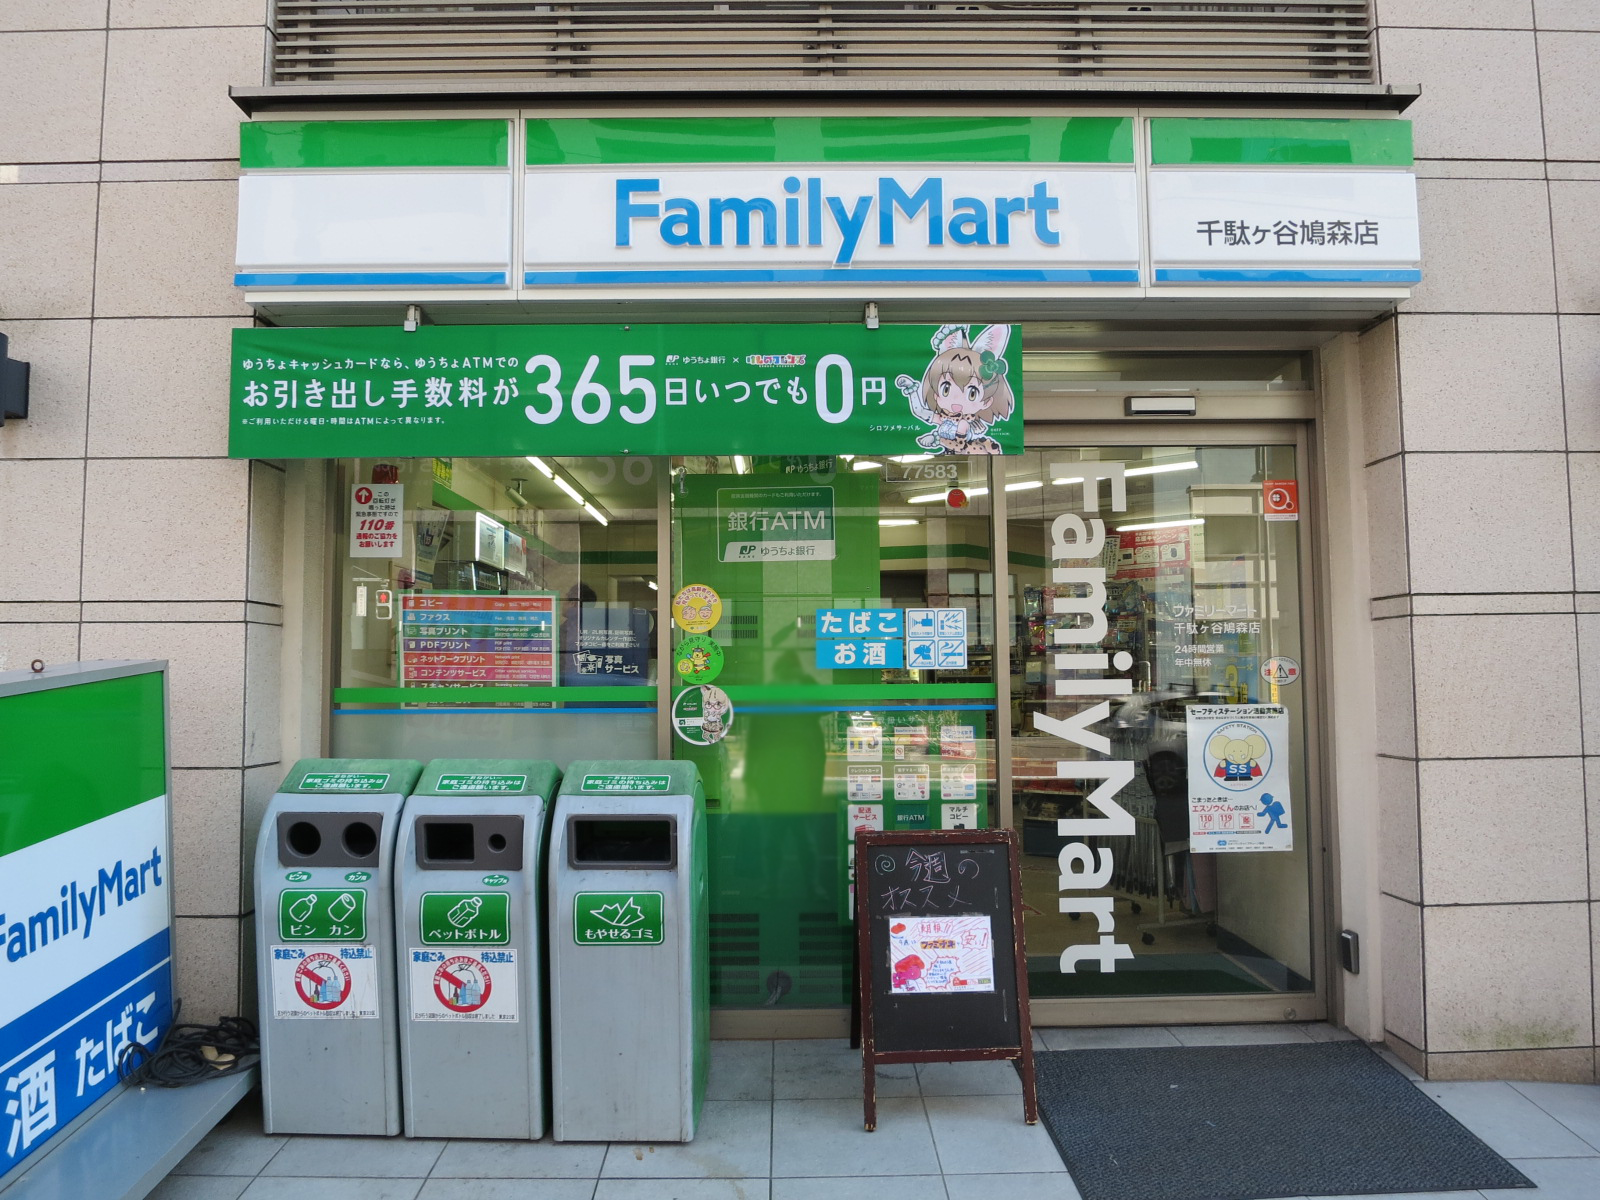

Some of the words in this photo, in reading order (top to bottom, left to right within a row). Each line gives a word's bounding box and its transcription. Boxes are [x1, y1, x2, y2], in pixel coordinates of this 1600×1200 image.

[614, 176, 1060, 267] FamilyMart
[1196, 219, 1379, 247] 千駄ヶ谷鳩森店
[242, 356, 519, 371] ゆうちょキャッシュカードなら、ゆうちょATMでの
[682, 355, 726, 364] ゆうちょ銀行
[242, 377, 519, 409] お引き出し手数料が
[524, 354, 656, 425] 365
[665, 376, 808, 406] 日いつでも
[814, 353, 854, 424] 0
[861, 376, 886, 405] 円
[868, 423, 921, 432] シロツメサーバル
[797, 458, 833, 474] ゆうちょ銀行
[901, 464, 958, 479] 77583
[359, 519, 395, 530] 110番
[727, 510, 825, 532] 銀行ATM
[760, 546, 816, 556] ゆうちょ銀行
[419, 599, 443, 607] コピー
[419, 613, 450, 621] ファクス
[1173, 604, 1257, 618] ファミリーマート
[821, 611, 898, 634] たばこ
[1173, 622, 1261, 634] 千駄ヶ谷鳩森店
[419, 628, 468, 636] 写真プリント
[420, 640, 471, 648] PDFプリント
[1174, 644, 1225, 654] 24時間営業
[420, 655, 486, 664] ネットワークプリント
[604, 655, 623, 664] 写真
[834, 642, 887, 666] お酒
[1174, 657, 1212, 667] 年中無休
[604, 665, 640, 674] サービス
[1033, 463, 1136, 974] FamilyMart
[1217, 724, 1235, 734] SAFETY
[1236, 723, 1258, 734] STATION
[1199, 815, 1213, 823] 110
[905, 847, 980, 884] 今週の
[880, 885, 973, 911] オススメ
[290, 924, 317, 936] ビン
[329, 924, 356, 936] カン
[429, 928, 502, 940] ペットボトル
[584, 928, 654, 940] もやせるゴミ
[274, 948, 306, 960] 家庭ごみ
[340, 947, 373, 959] 持込禁止
[413, 951, 446, 963] 家庭ごみ
[481, 951, 514, 963] 持込禁止
[5, 1049, 58, 1158] 酒
[75, 990, 160, 1098] たばこ
